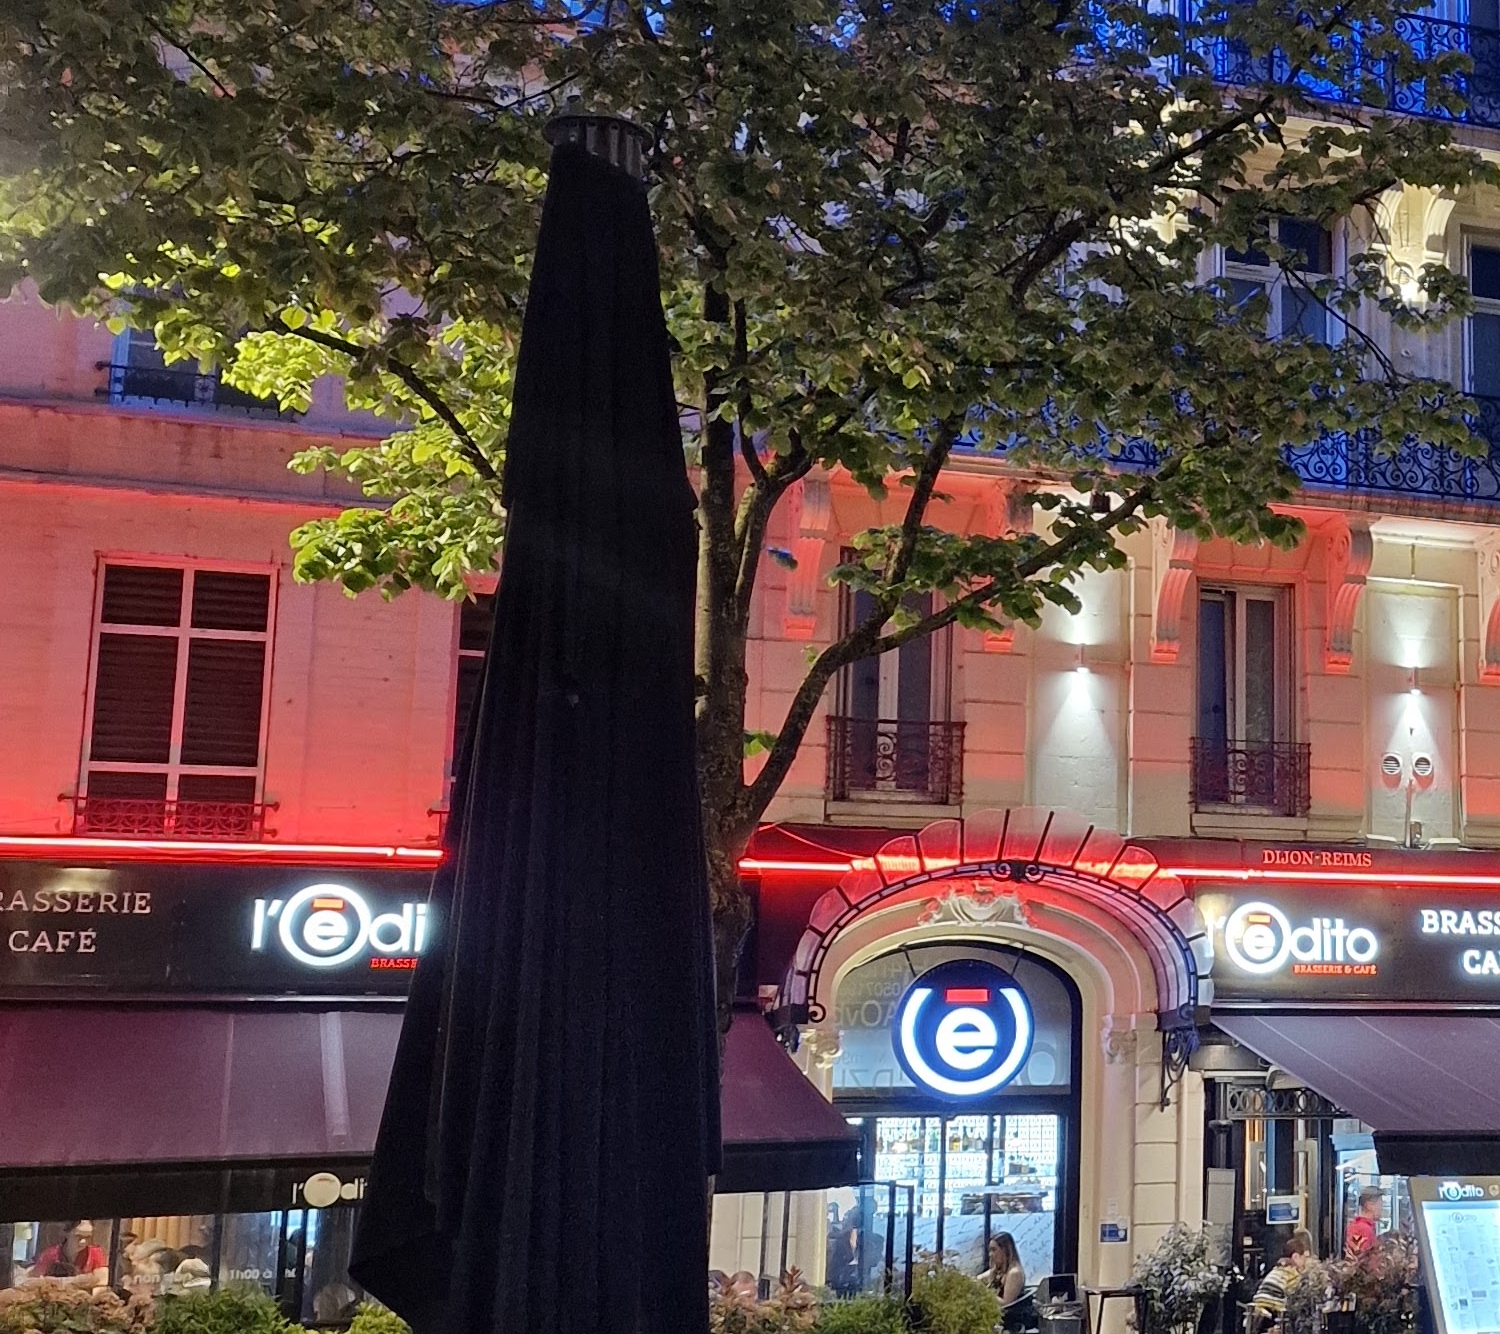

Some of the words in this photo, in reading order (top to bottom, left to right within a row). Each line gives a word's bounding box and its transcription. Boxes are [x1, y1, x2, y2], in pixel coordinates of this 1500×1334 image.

[1262, 849, 1372, 867] DIJON-REIMS
[0, 889, 151, 914] ASSERIE
[8, 928, 97, 953] CAFÉ
[370, 958, 418, 969] BRASSE
[1294, 964, 1343, 974] BRASSERIE
[1344, 964, 1353, 975] &
[1353, 964, 1377, 975] CAFÉ
